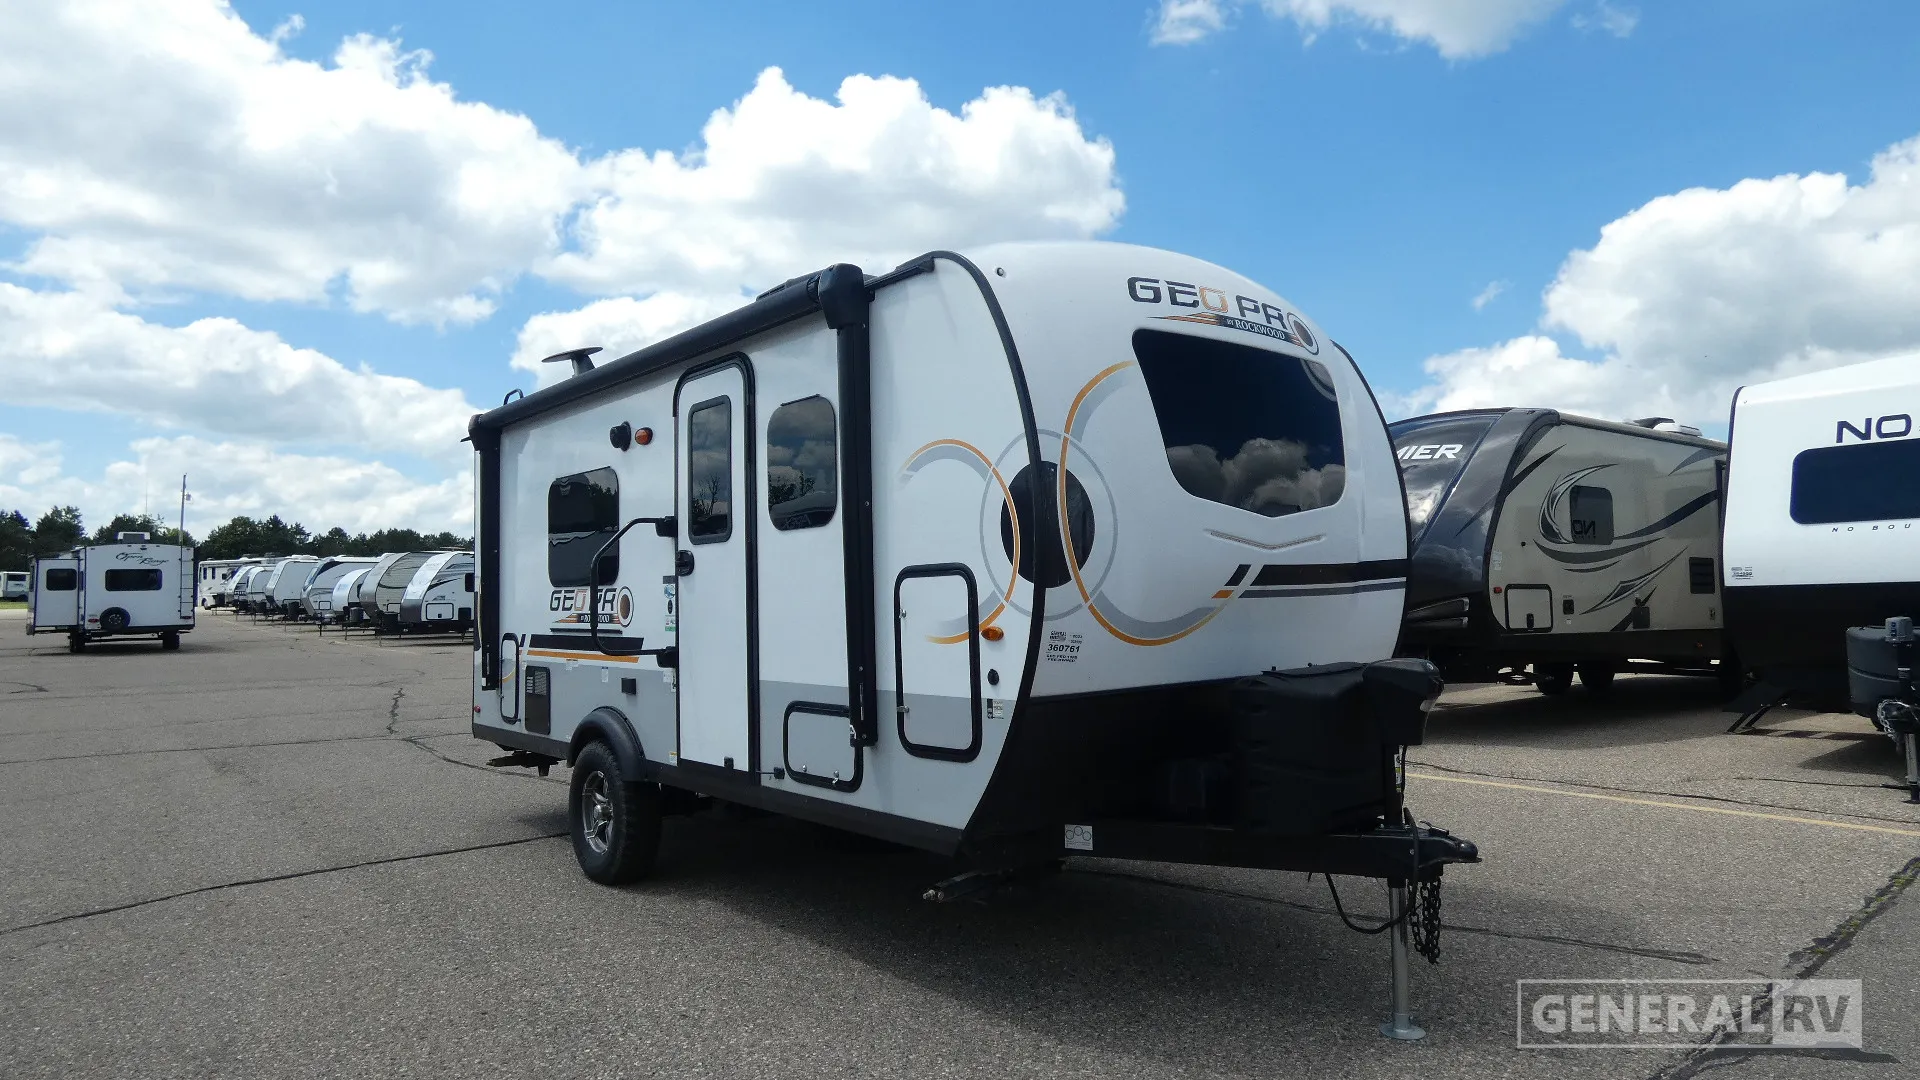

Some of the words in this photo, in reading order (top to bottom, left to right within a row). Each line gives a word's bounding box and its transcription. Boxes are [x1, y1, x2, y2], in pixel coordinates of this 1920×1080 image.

[1127, 276, 1229, 313] GEO
[1235, 295, 1320, 356] PRO
[1235, 319, 1286, 340] ROCKWOOD
[549, 588, 588, 611] GEO
[1047, 643, 1080, 653] 360761
